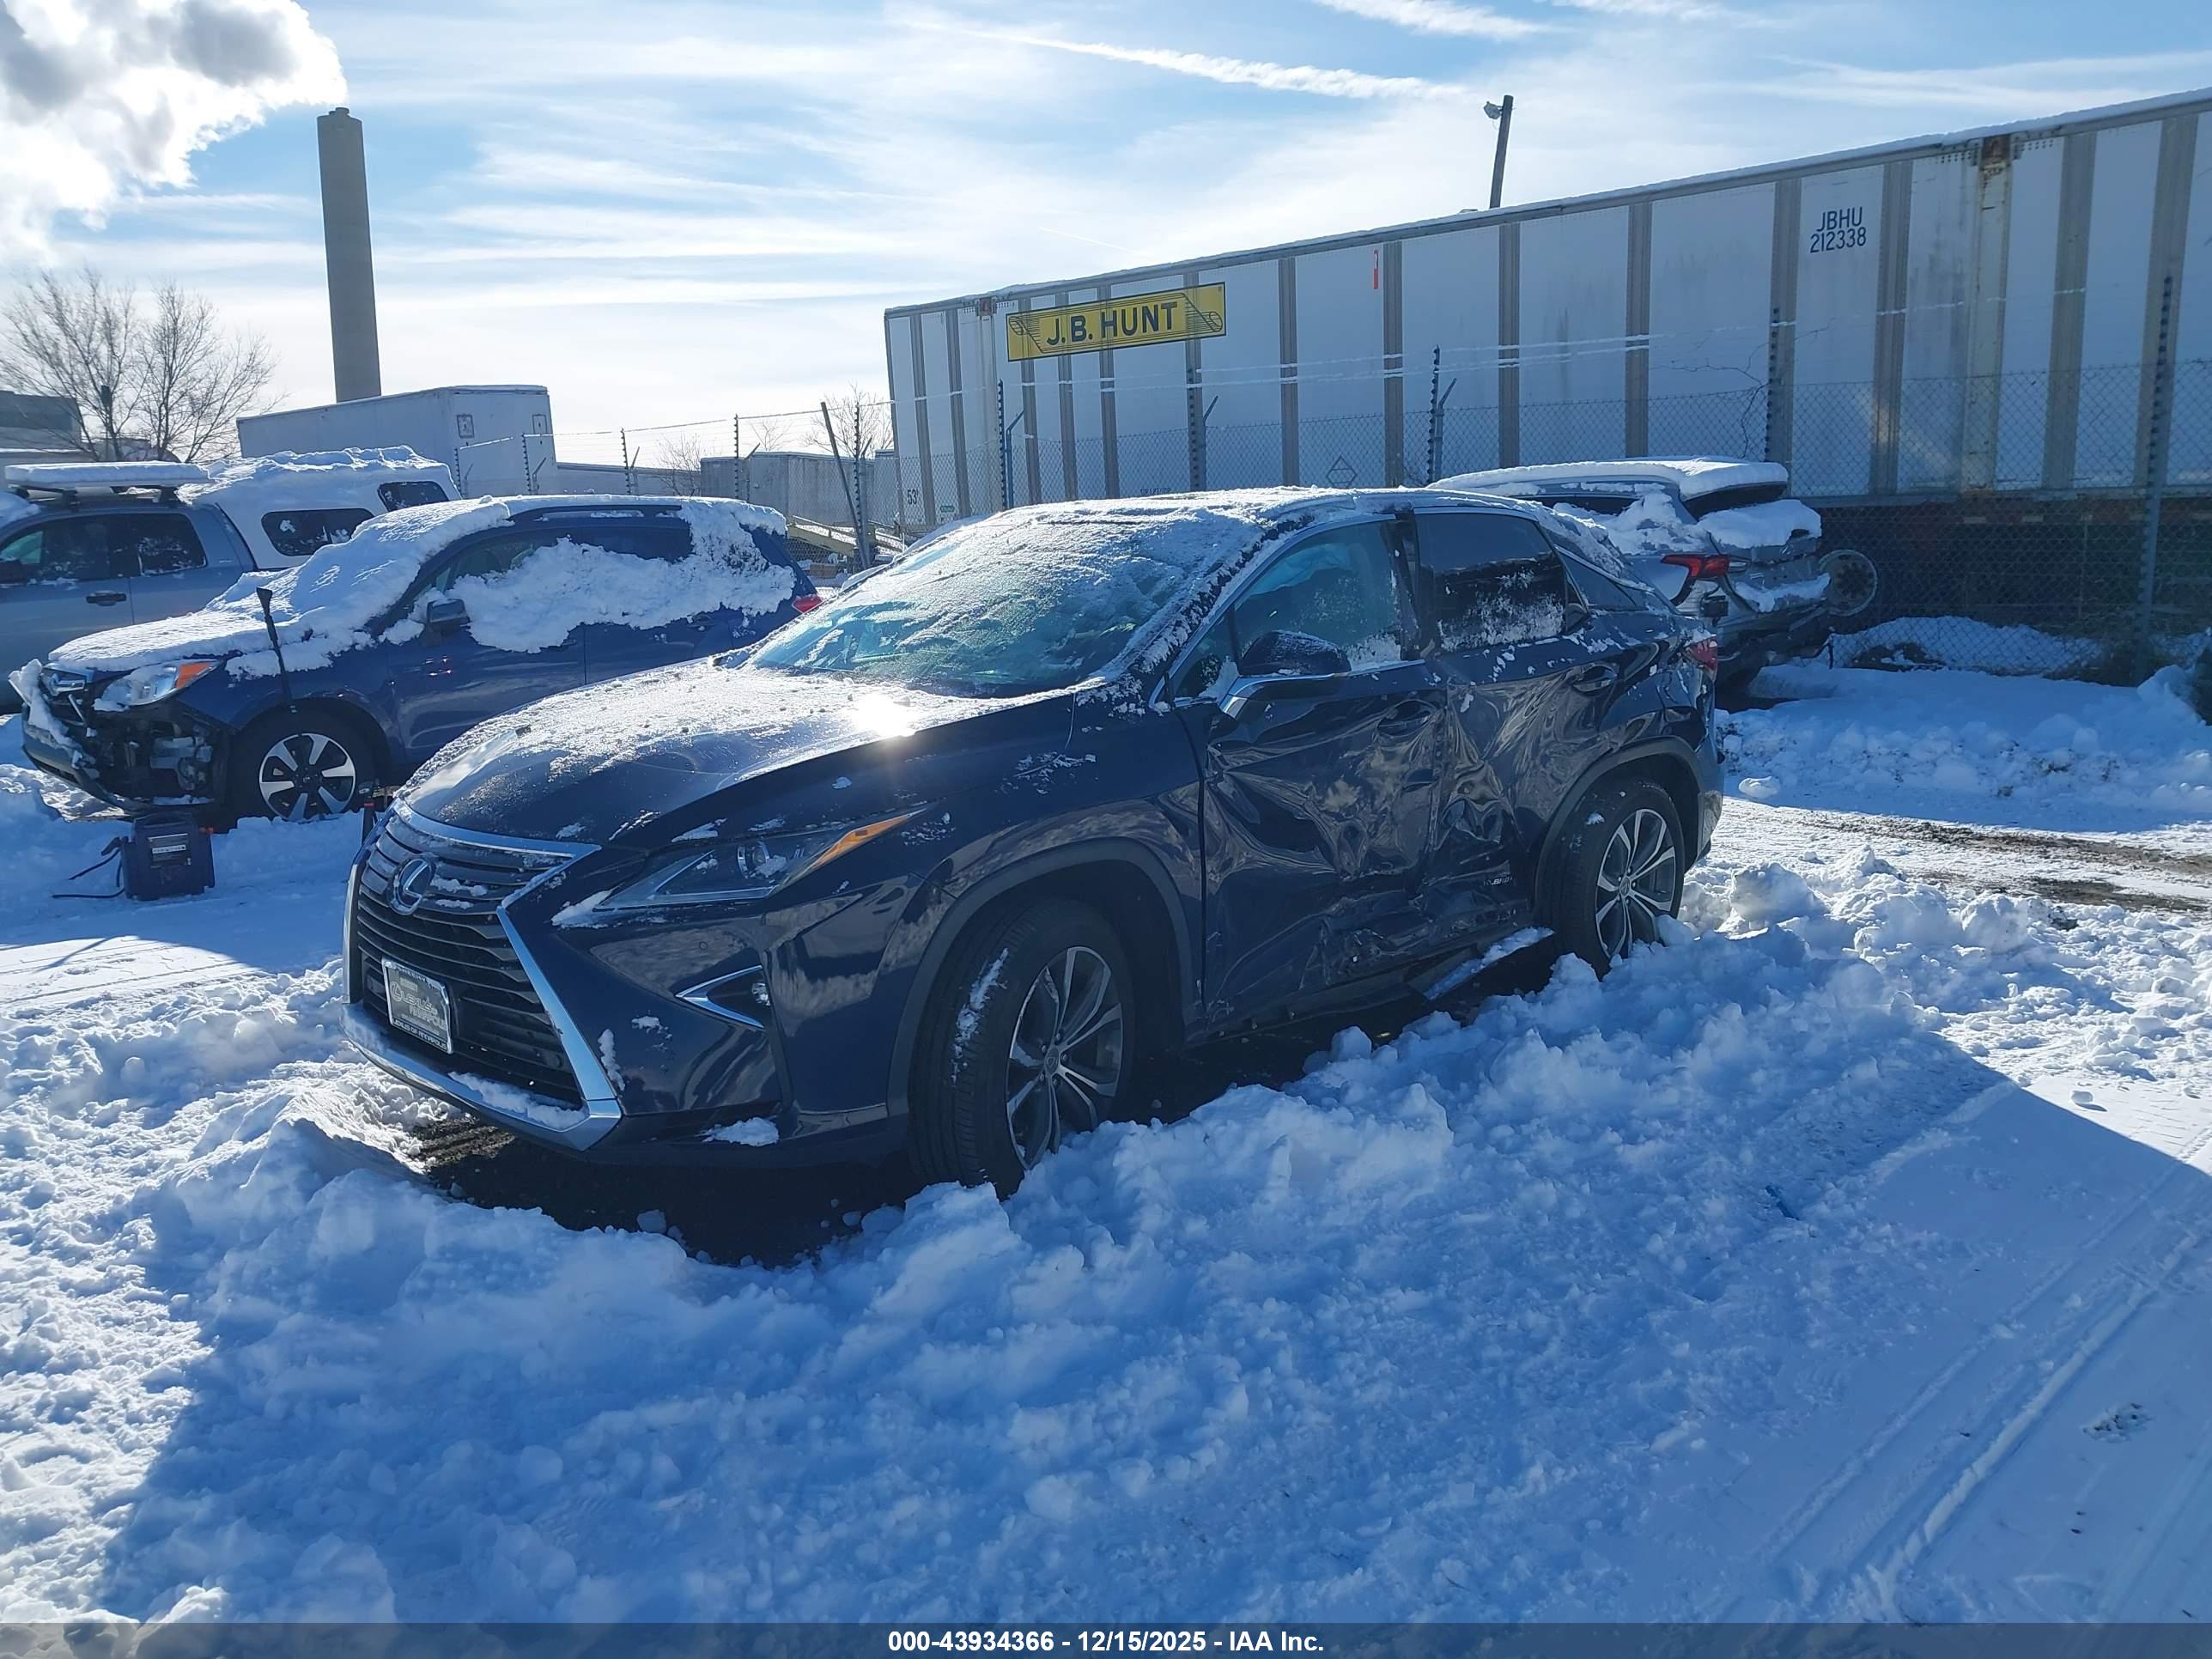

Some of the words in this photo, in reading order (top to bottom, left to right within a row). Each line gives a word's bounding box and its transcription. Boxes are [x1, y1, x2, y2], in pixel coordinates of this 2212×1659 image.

[1816, 206, 1863, 232] JBHU
[1810, 227, 1867, 253] 212338
[1046, 315, 1093, 345] J.B.
[1101, 301, 1178, 337] HUNT
